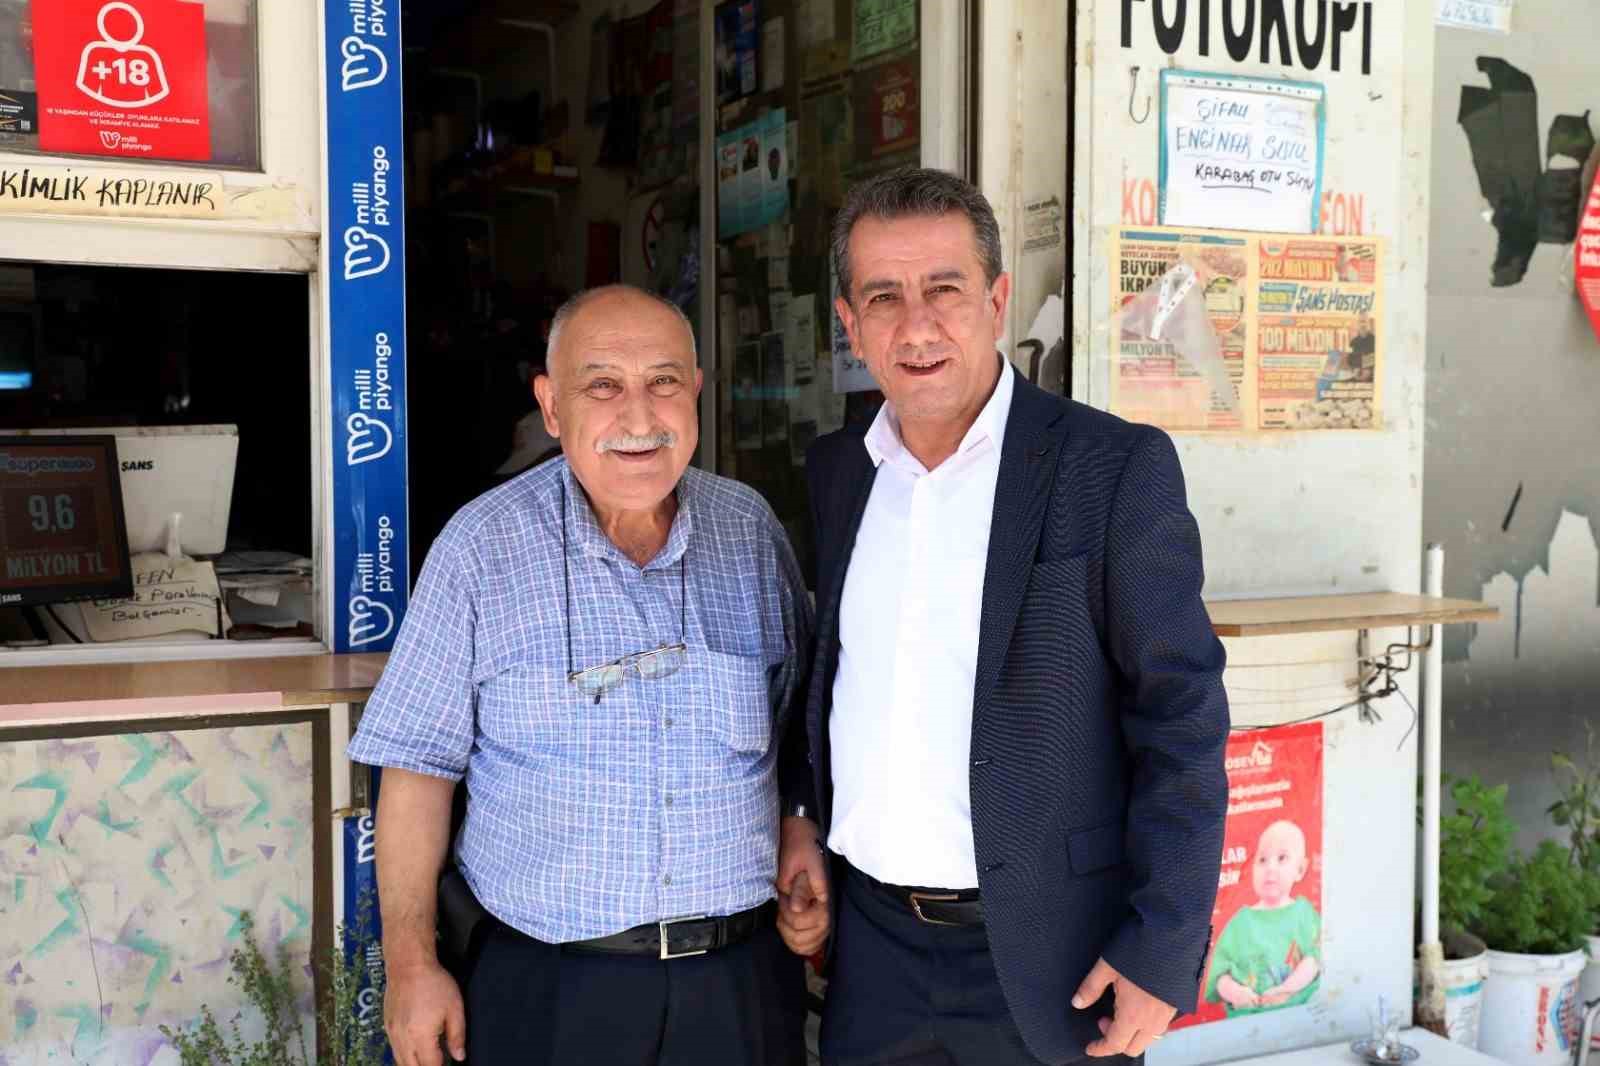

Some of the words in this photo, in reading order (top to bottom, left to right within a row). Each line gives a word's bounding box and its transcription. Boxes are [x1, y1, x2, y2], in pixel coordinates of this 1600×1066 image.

[92, 59, 150, 87] +18
[0, 168, 88, 201] KİMLİK
[96, 177, 215, 210] KAPLANIR
[352, 182, 369, 224] milli
[371, 145, 390, 226] piyango
[1120, 259, 1168, 276] BÜYÜK
[354, 369, 371, 410] milli
[372, 332, 392, 410] piyango
[357, 553, 374, 592] milli
[376, 515, 394, 592] piyango
